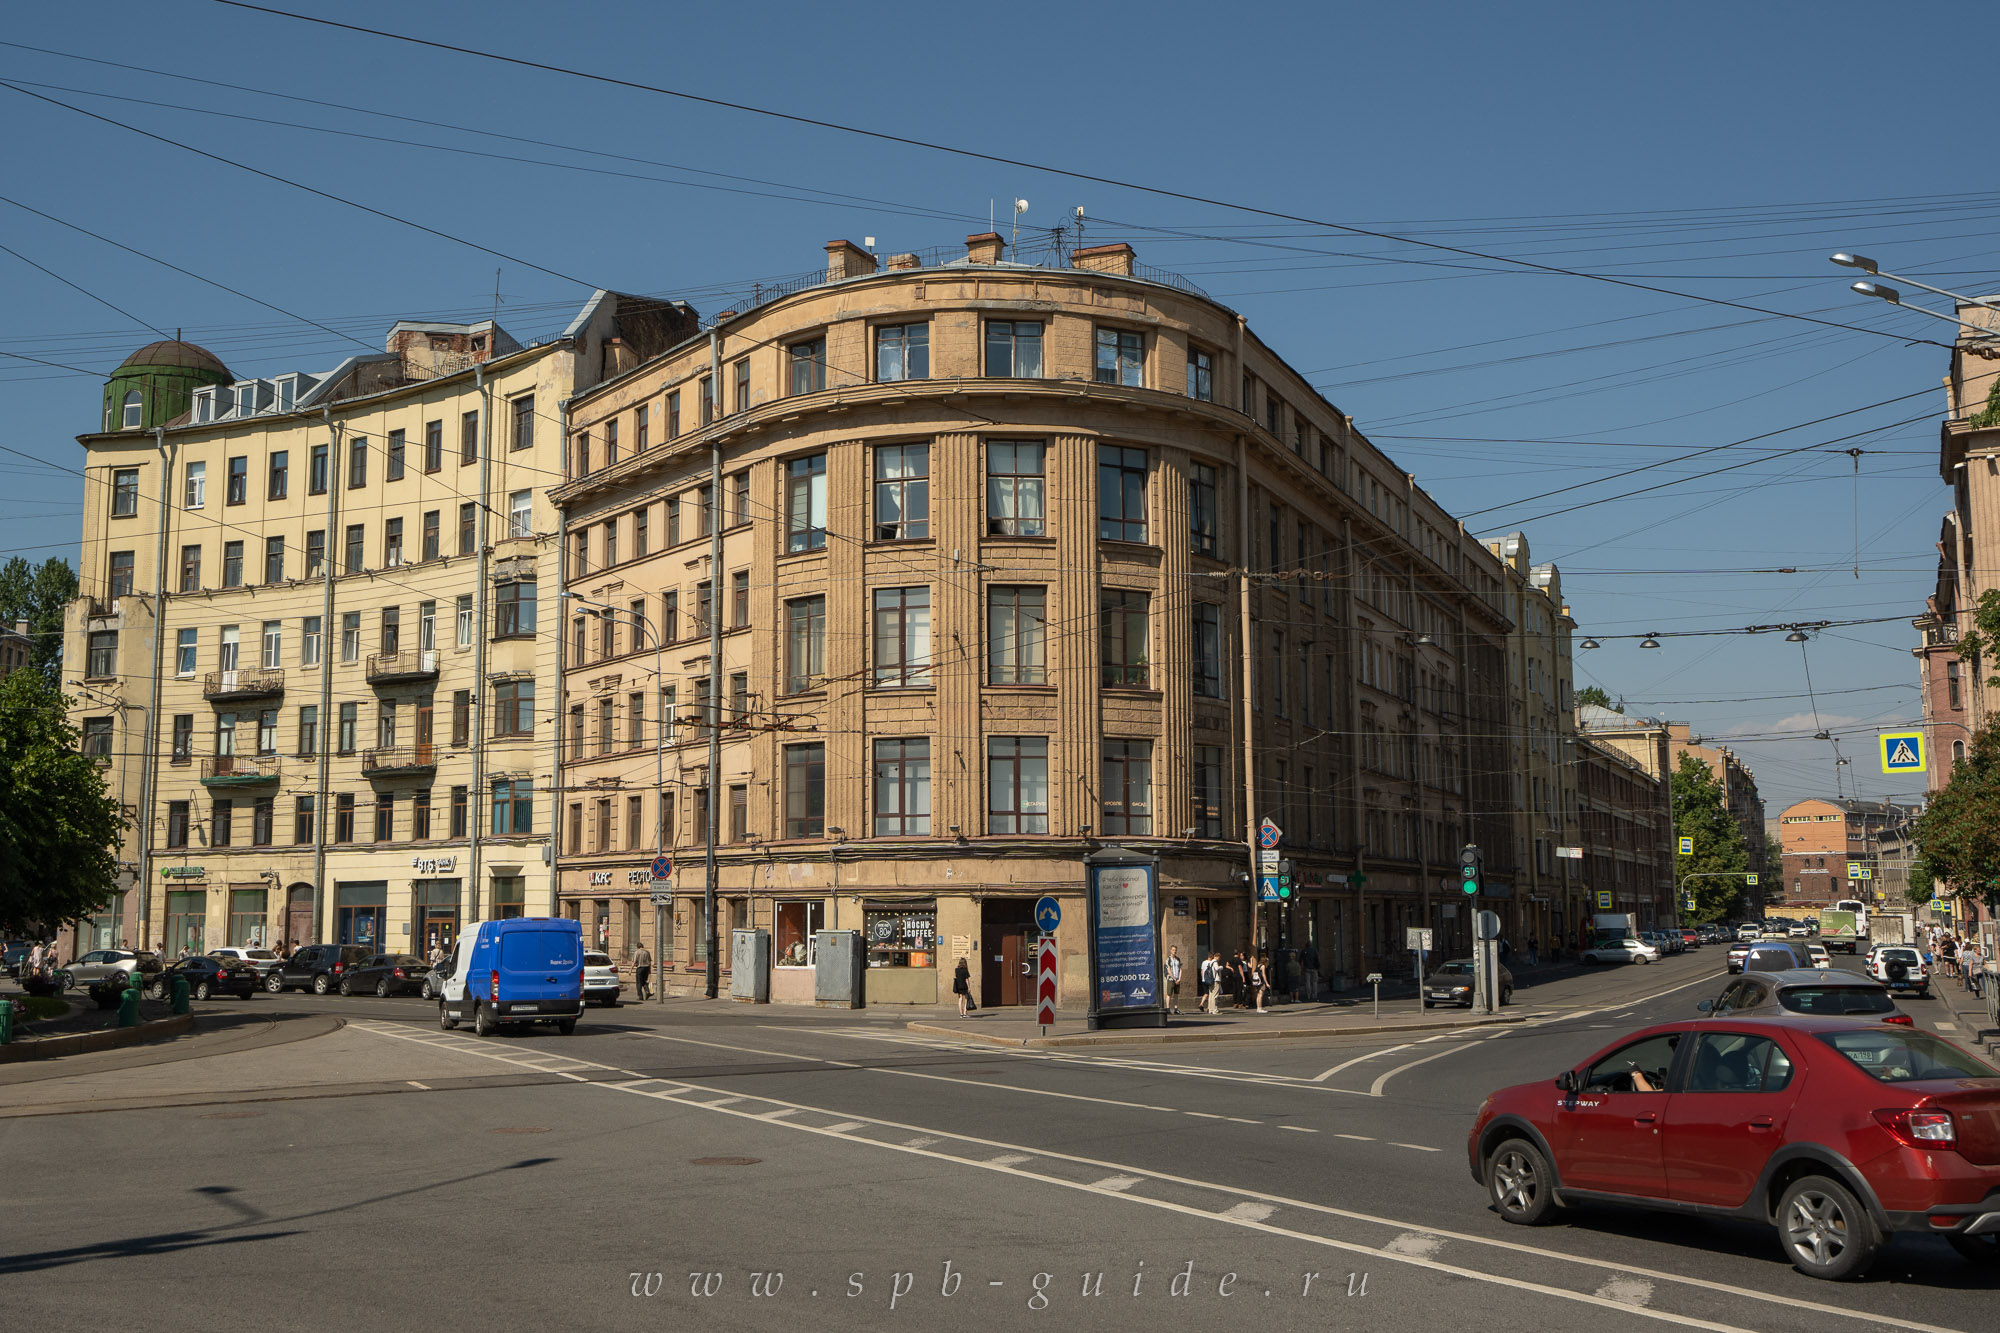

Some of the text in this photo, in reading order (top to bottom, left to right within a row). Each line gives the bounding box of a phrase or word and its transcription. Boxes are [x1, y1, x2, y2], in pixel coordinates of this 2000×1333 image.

[418, 859, 434, 871] ВТБ
[1464, 867, 1475, 876] 57
[595, 872, 611, 883] KFC
[1280, 875, 1290, 884] 57
[907, 930, 932, 938] COFFEE
[1120, 974, 1137, 982] 2000
